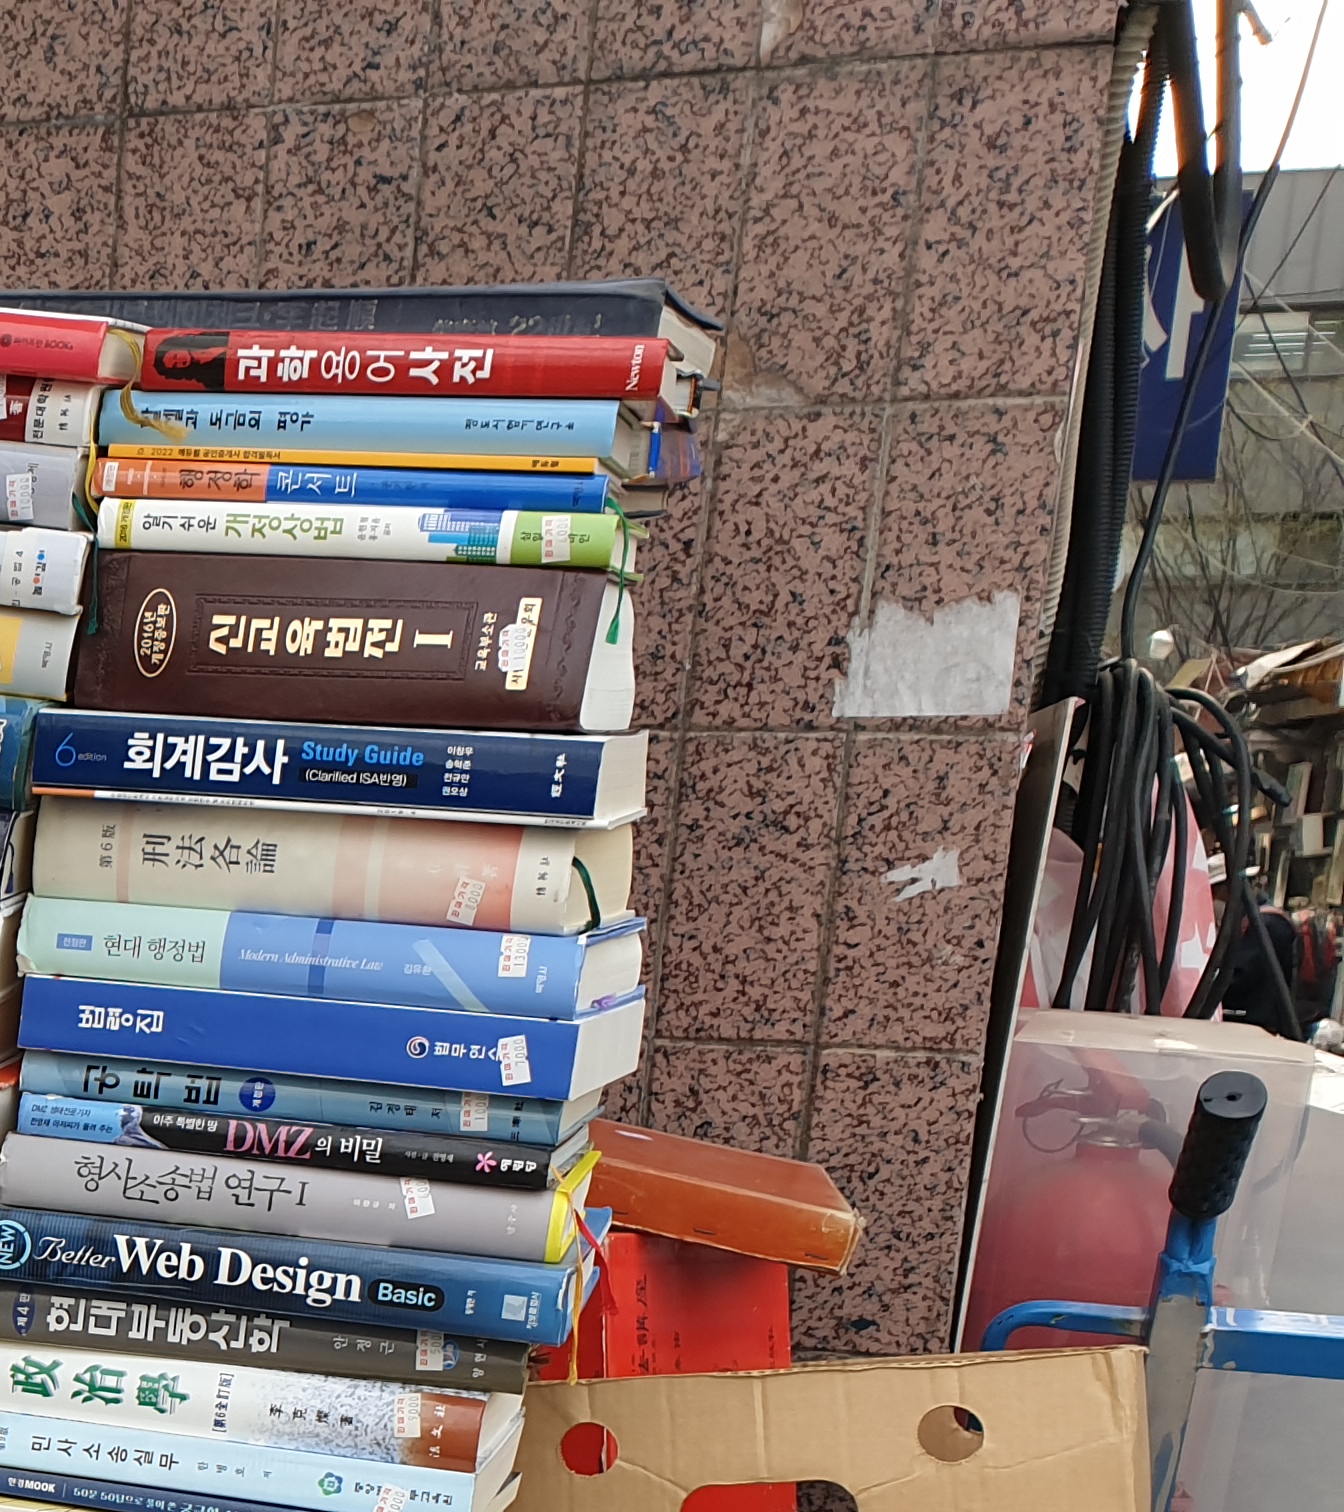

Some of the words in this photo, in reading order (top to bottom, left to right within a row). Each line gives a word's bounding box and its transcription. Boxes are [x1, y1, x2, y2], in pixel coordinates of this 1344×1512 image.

[236, 344, 494, 386] 과학용어사전
[623, 344, 645, 391] Newton
[223, 512, 344, 542] 개정상법
[208, 613, 405, 659] 신교육법전
[123, 731, 288, 785] 회계감사
[301, 741, 358, 766] Study
[365, 744, 424, 766] Guide
[141, 833, 278, 875] 刑法各論
[77, 1006, 164, 1032] 법령집
[226, 1120, 312, 1158] DMZ
[315, 1136, 332, 1155] 의
[339, 1135, 382, 1162] 비밀
[224, 1173, 291, 1210] 연구
[39, 1234, 115, 1269] Better
[113, 1234, 205, 1281] Web
[214, 1253, 362, 1305] Design
[377, 1284, 435, 1308] Basic
[46, 1294, 289, 1352] 현대부동산학
[9, 1355, 191, 1415] 政治學
